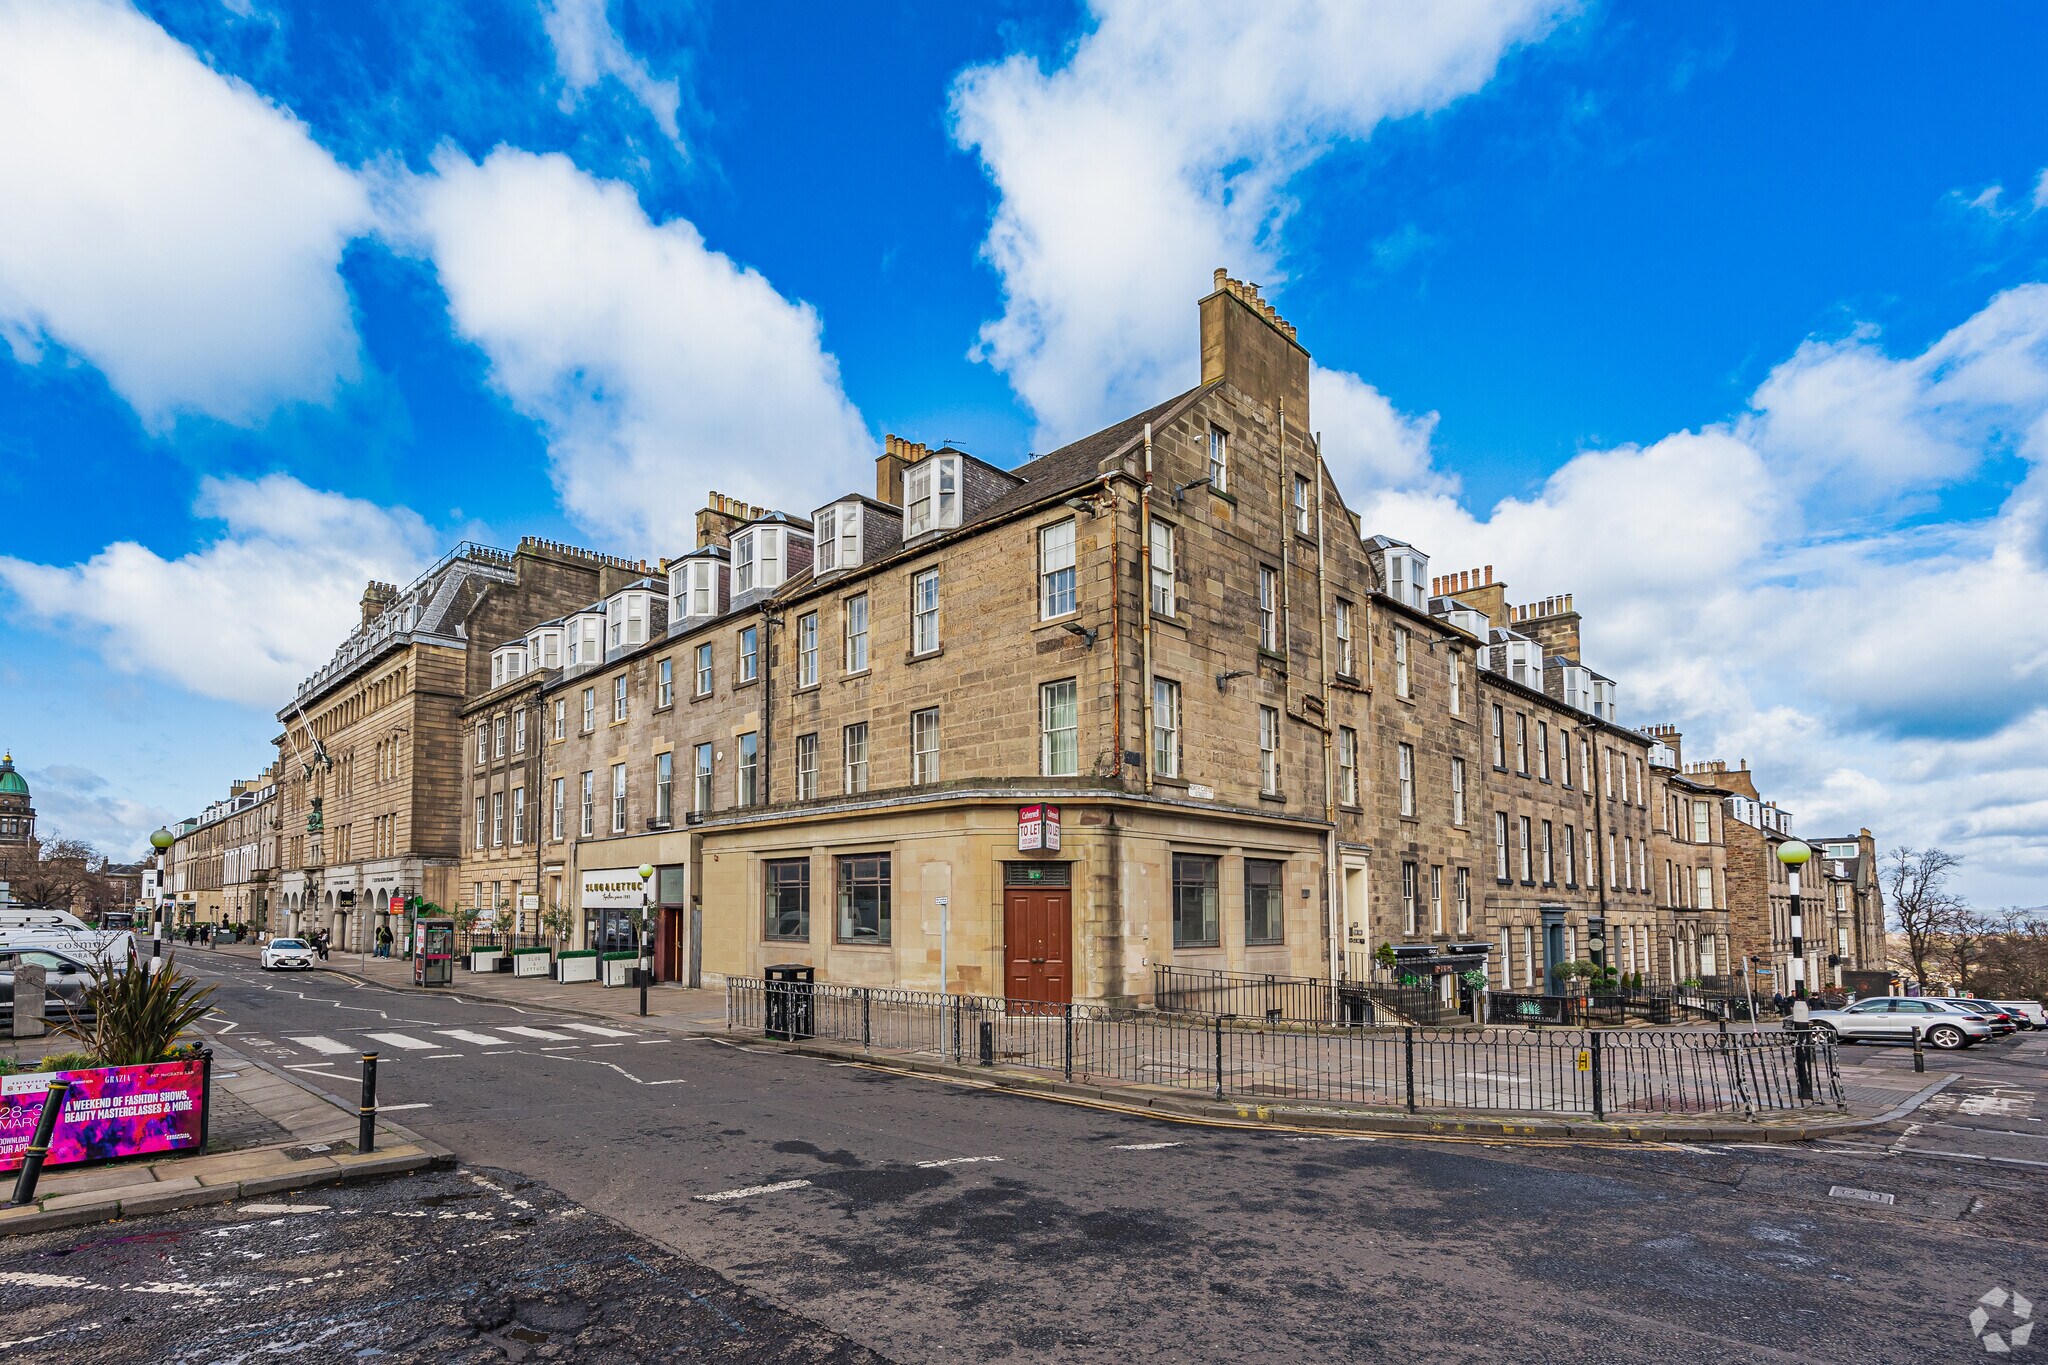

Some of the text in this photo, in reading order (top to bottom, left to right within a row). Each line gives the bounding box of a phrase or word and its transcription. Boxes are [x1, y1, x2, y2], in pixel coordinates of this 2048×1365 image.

[1020, 823, 1040, 836] TO LET
[105, 1074, 131, 1084] GRAZIA
[65, 1090, 190, 1112] A WEEKEND OF FASHION SHOWS,
[65, 1100, 193, 1123] BEAUTY MASTERCLASSES & MORE
[0, 1117, 39, 1130] MARC
[14, 1143, 29, 1153] APP
